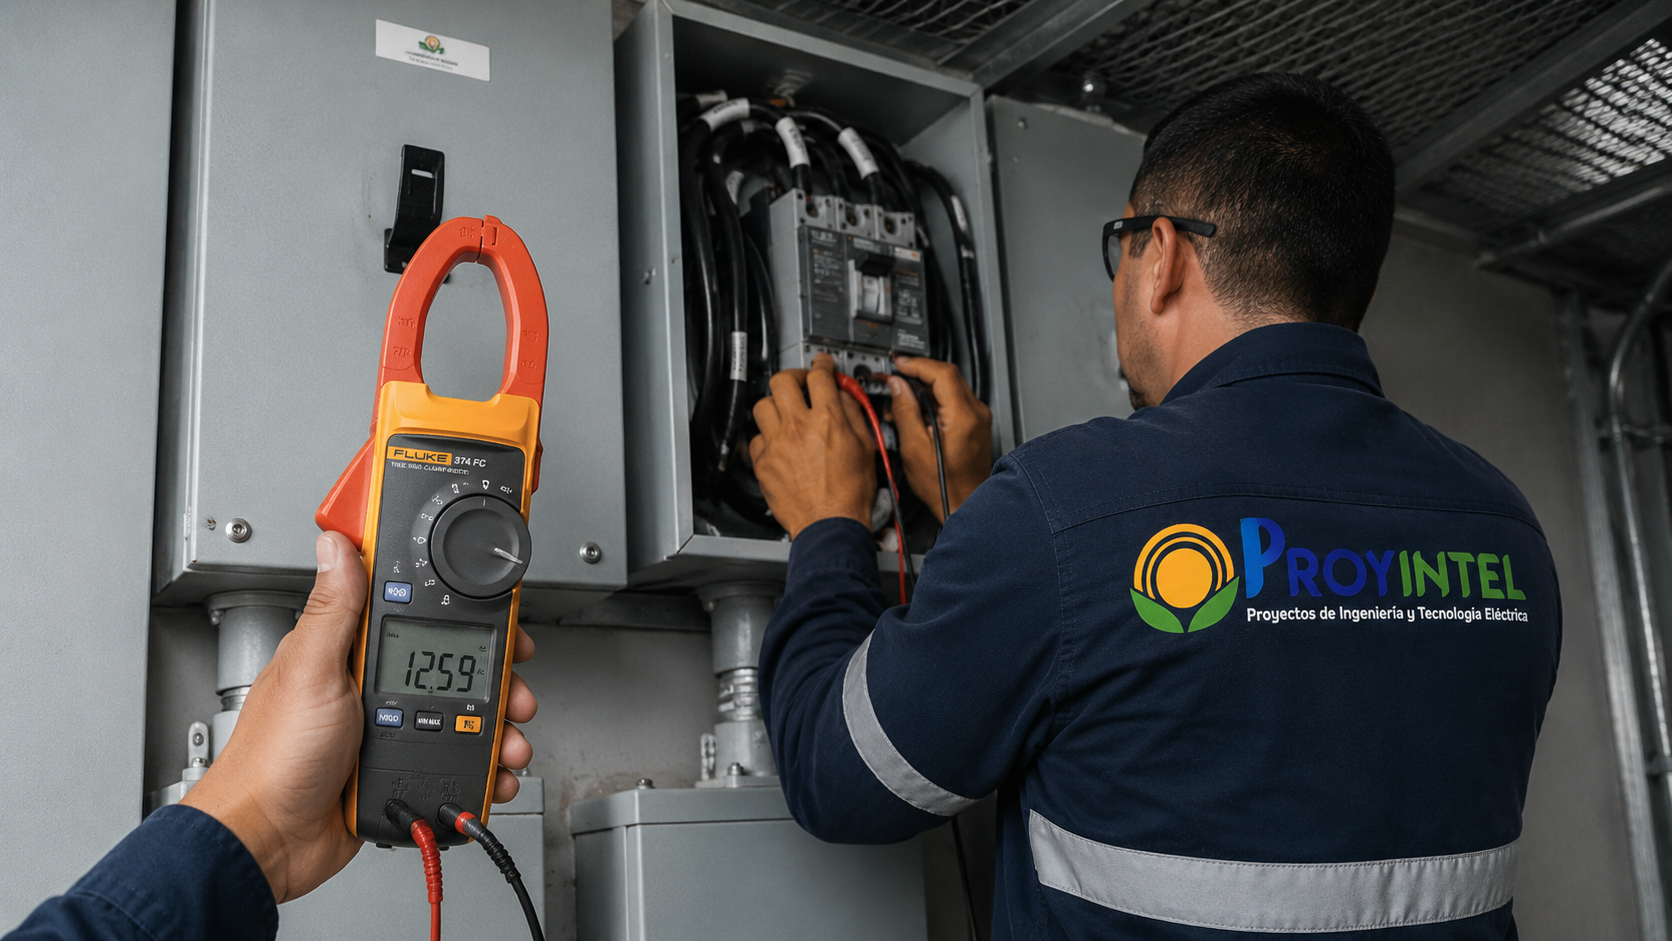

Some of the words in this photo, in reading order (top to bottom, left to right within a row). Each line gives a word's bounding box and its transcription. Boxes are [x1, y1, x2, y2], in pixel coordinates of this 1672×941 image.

[393, 449, 448, 463] FLUKE
[454, 456, 471, 466] 374
[472, 458, 487, 468] FC
[1240, 517, 1527, 600] PROYINTEL
[1246, 607, 1317, 624] Proyectos
[1319, 605, 1336, 620] de
[1339, 605, 1404, 622] Ingeniería
[1406, 609, 1415, 622] y
[1485, 607, 1528, 622] Eléctrica
